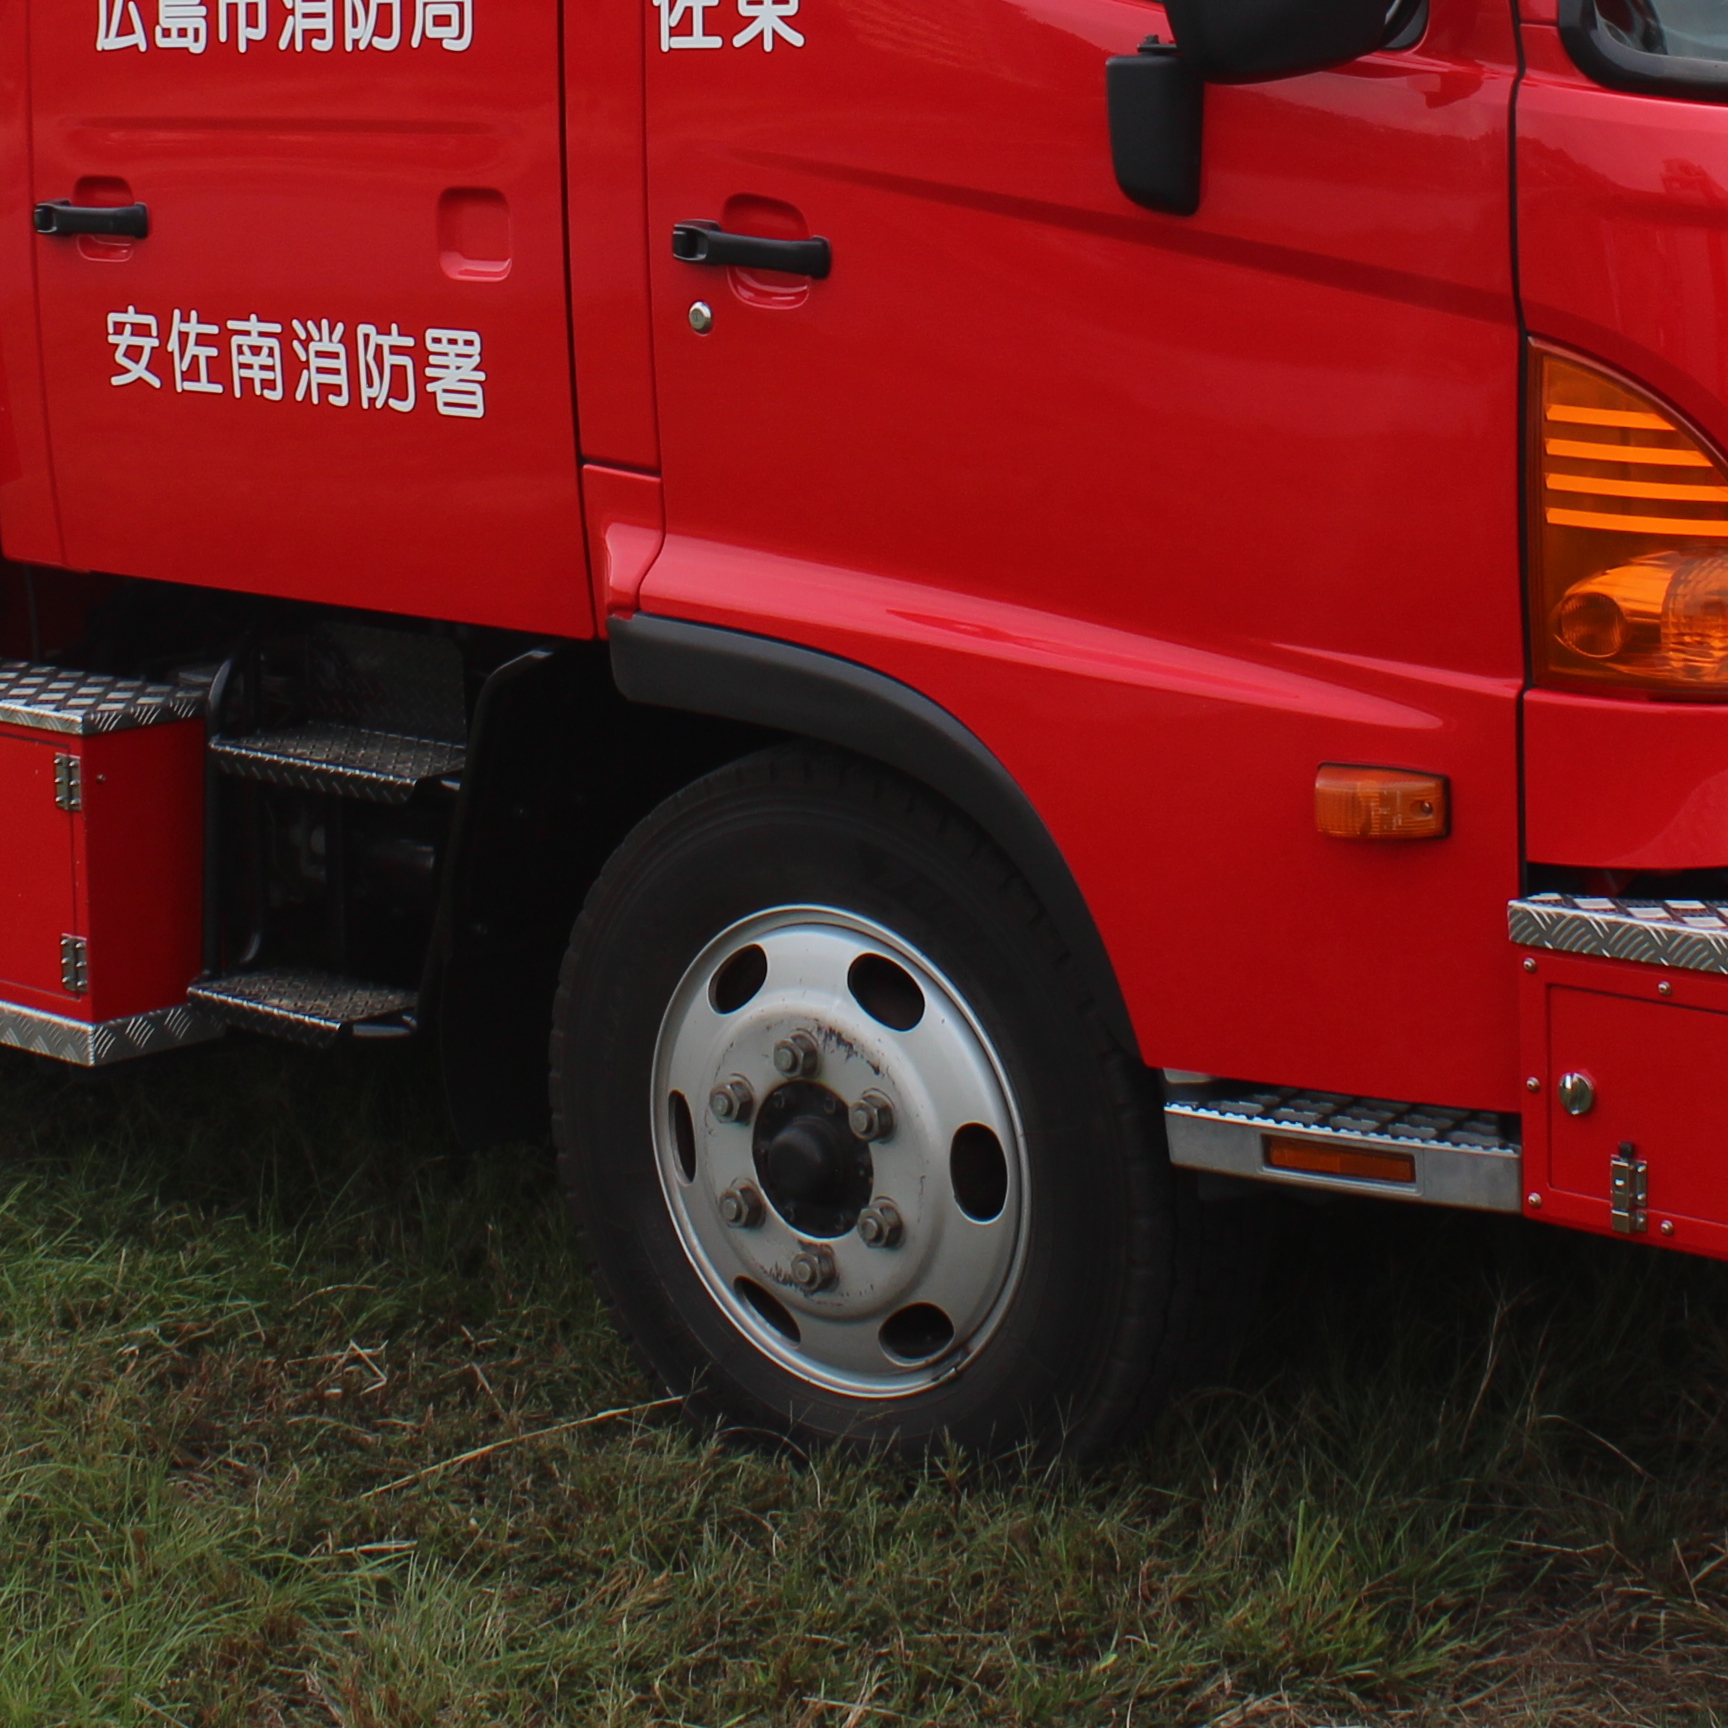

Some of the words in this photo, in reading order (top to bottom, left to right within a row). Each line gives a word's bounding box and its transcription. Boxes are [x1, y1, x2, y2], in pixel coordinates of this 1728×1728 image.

[106, 305, 488, 419] 安佐南消防署
